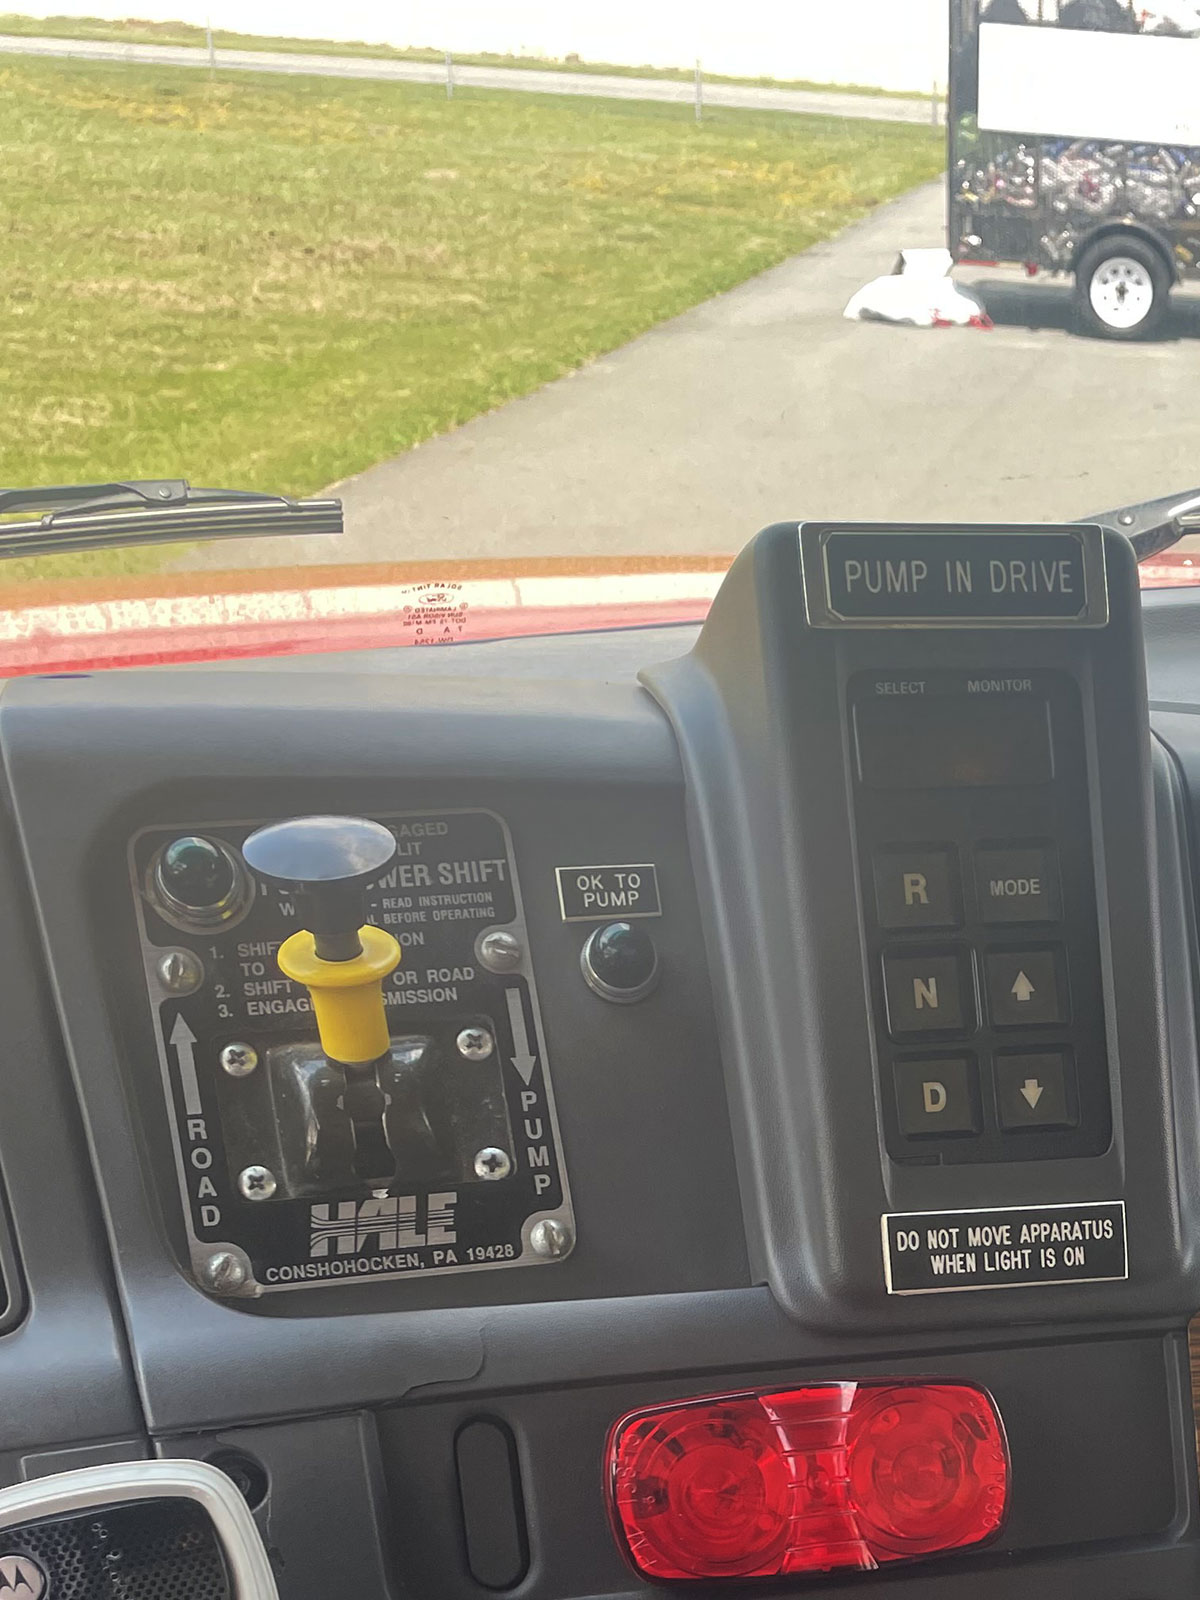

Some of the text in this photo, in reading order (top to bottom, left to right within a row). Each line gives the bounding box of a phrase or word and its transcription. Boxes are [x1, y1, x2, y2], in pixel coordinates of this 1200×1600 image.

[844, 560, 1073, 593] PUMP IN DRIVE
[875, 679, 1032, 695] SELECT MONITOR
[440, 859, 506, 885] SHIFT
[576, 873, 642, 890] OK TO
[990, 878, 1040, 896] MODE
[383, 892, 493, 909] READ INSTRUCTION
[584, 890, 640, 908] PUMP
[903, 873, 929, 905] R
[384, 911, 428, 924] BEFORE
[433, 908, 495, 921] OPERATING
[216, 967, 474, 998] 2. SHIFT OR ROAD
[241, 962, 265, 977] TO
[913, 977, 939, 1009] N
[219, 1004, 233, 1018] 3.
[922, 1081, 948, 1113] D
[521, 1091, 551, 1196] PUMP
[188, 1120, 220, 1227] ROAD
[310, 1192, 458, 1258] HALE
[896, 1219, 1114, 1252] DO NOT MOVE APPARATUS
[266, 1244, 514, 1282] CONSHOHOCKEN, PA 19428
[930, 1246, 1085, 1275] WHEN LIGHT IS ON
